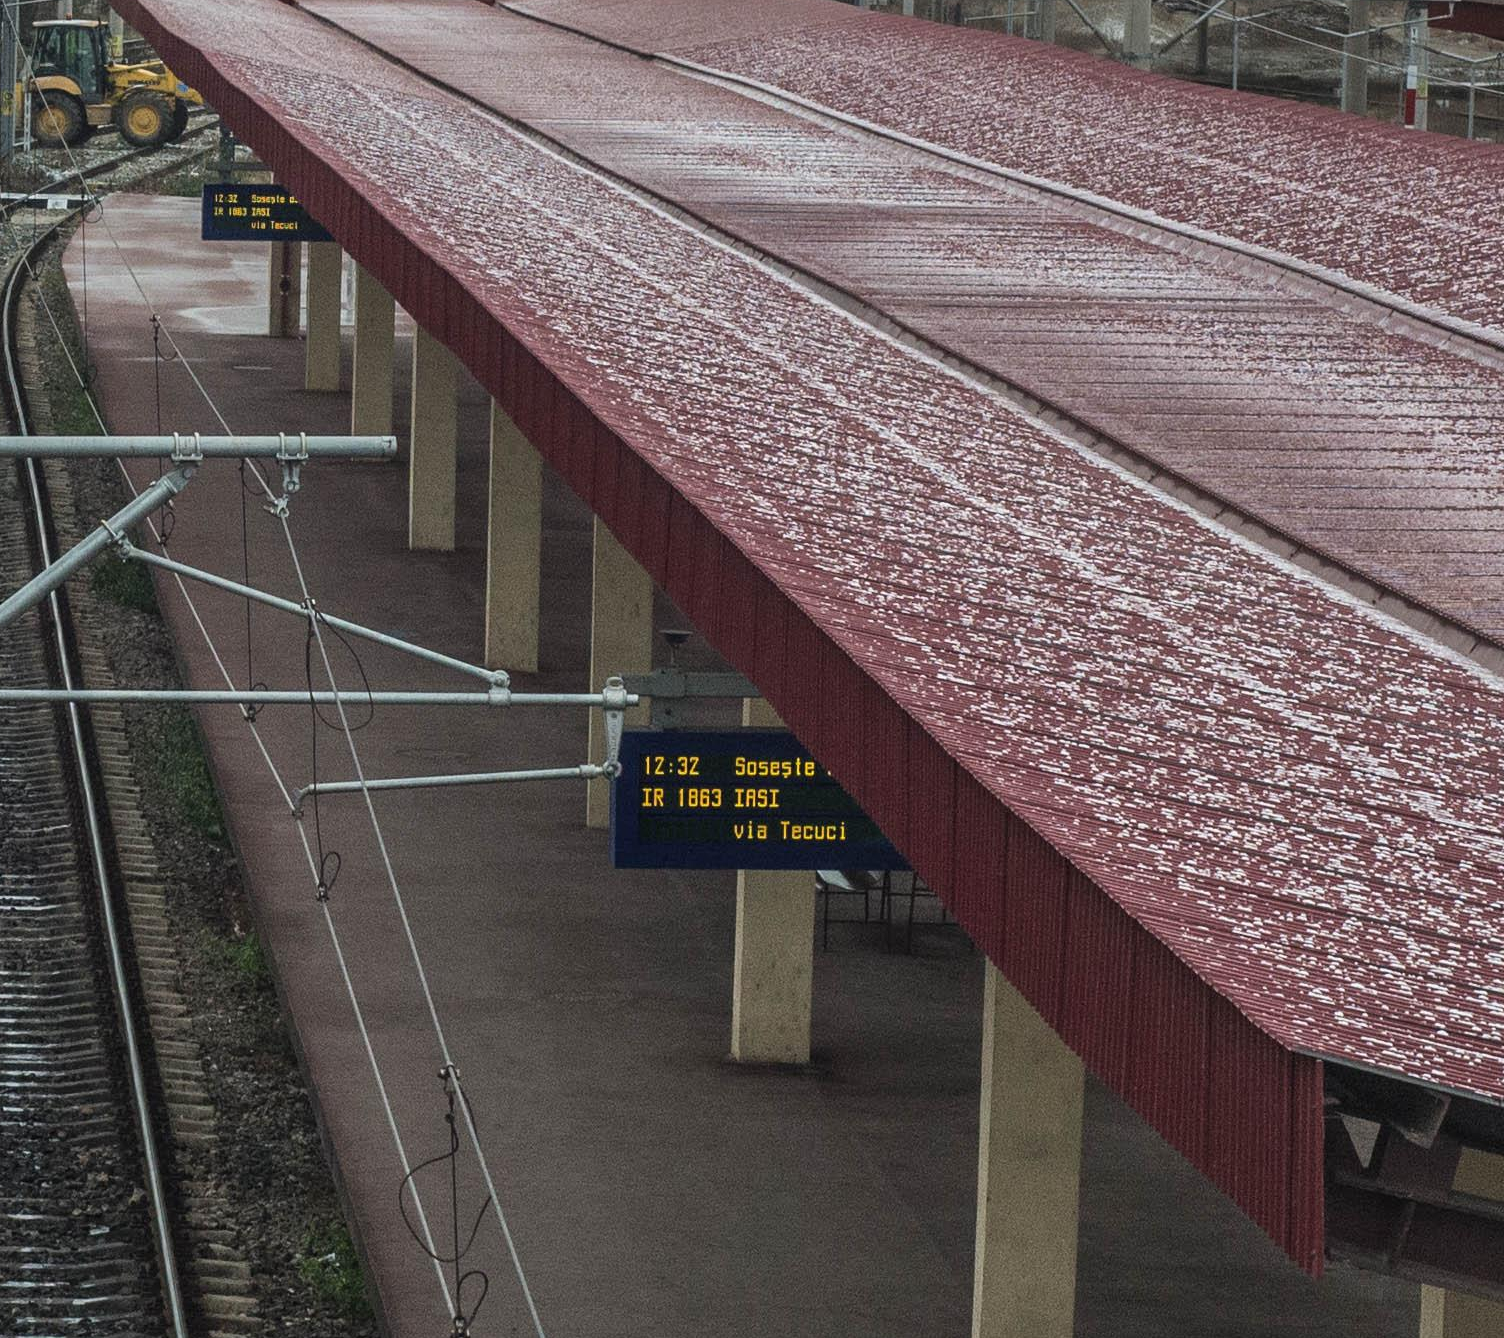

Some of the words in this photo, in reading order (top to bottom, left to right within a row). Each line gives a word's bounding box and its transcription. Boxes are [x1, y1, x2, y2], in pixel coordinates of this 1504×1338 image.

[645, 756, 700, 775] 12:32
[642, 788, 664, 807] IR
[679, 788, 722, 808] 1863
[734, 788, 779, 808] IASI
[734, 821, 767, 840] via
[780, 820, 846, 841] Tecuci
